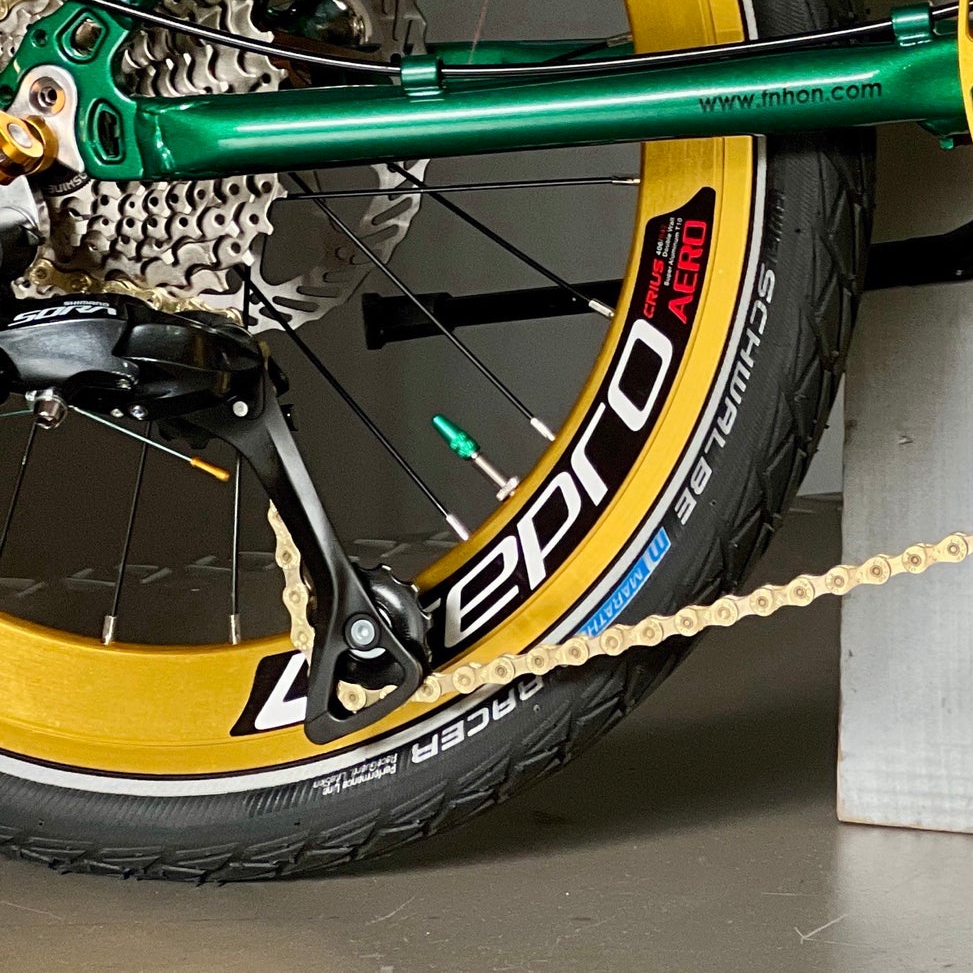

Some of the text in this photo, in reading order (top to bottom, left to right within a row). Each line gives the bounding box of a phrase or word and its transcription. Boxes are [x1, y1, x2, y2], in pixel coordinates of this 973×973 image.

[699, 80, 883, 113] www.fnhon.com
[643, 258, 664, 319] CRIUS
[668, 220, 707, 325] AERO
[7, 305, 118, 327] SORA
[674, 263, 776, 525] SCHWALBE
[255, 319, 673, 730] Lepro
[586, 568, 644, 637] MARATH
[411, 679, 544, 764] RACER
